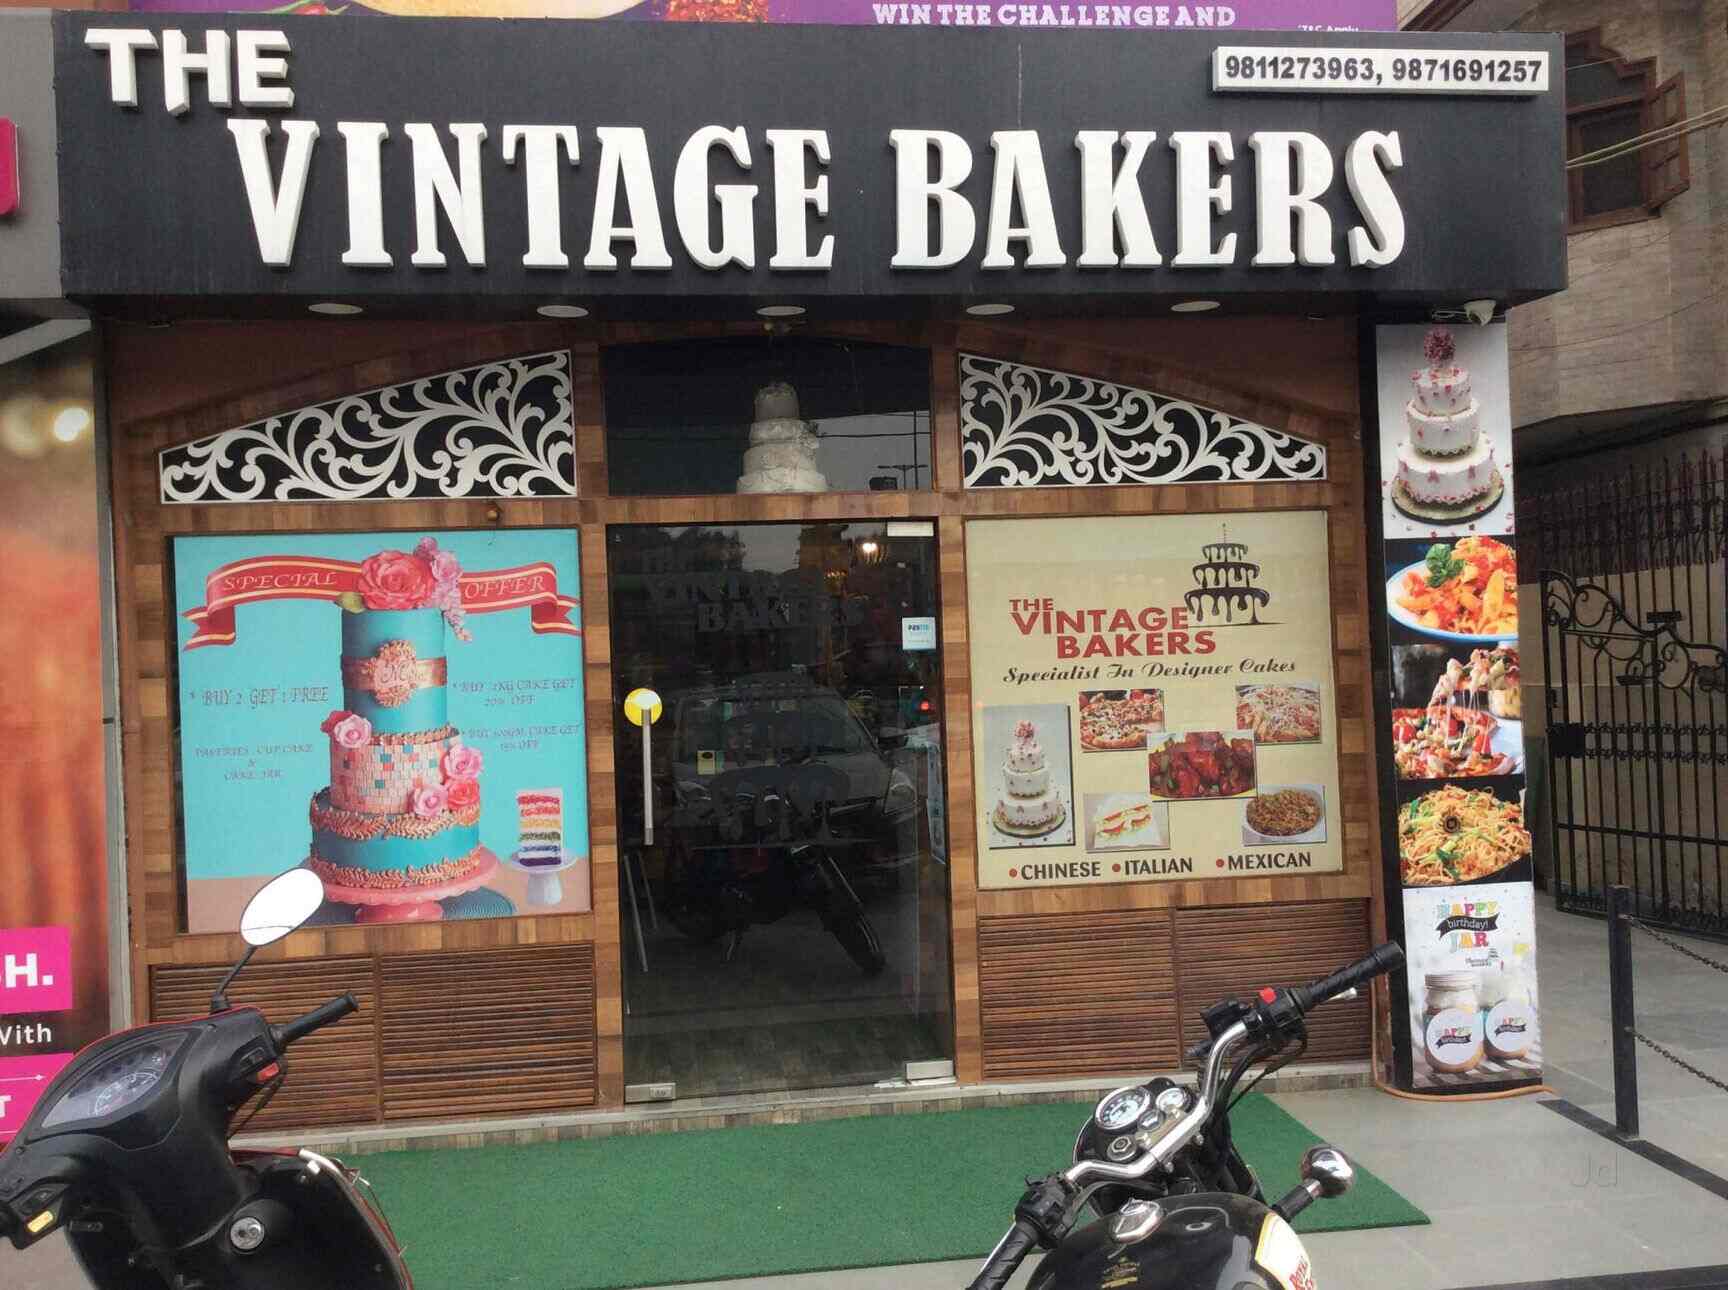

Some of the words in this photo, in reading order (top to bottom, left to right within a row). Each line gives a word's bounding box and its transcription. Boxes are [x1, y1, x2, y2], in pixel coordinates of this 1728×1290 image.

[873, 4, 931, 25] WIN
[937, 4, 991, 25] THE
[998, 4, 1170, 26] CHALLENGE
[1174, 6, 1236, 26] AND
[85, 28, 295, 115] THE
[1226, 55, 1383, 85] 9811273963,
[1392, 59, 1542, 82] 9871691257
[227, 118, 836, 271] VINTAGE
[889, 129, 1407, 269] BAKERS
[223, 572, 337, 591] SPECIAL
[464, 575, 545, 599] OFFER
[1009, 598, 1054, 612] THE
[1010, 607, 1189, 635] VINTAGE
[1057, 630, 1217, 659] BAKERS
[1003, 666, 1099, 685] Specialist
[1107, 664, 1134, 678] In
[1141, 661, 1233, 680] Designer
[1239, 656, 1296, 673] Cakes
[203, 688, 232, 706] BUY
[250, 687, 278, 709] GET
[289, 686, 329, 703] FREE
[1021, 861, 1101, 880] CHINESE
[1125, 857, 1193, 875] ITALIAN
[1228, 852, 1312, 870] MEXICAN
[1447, 917, 1489, 930] birthday!
